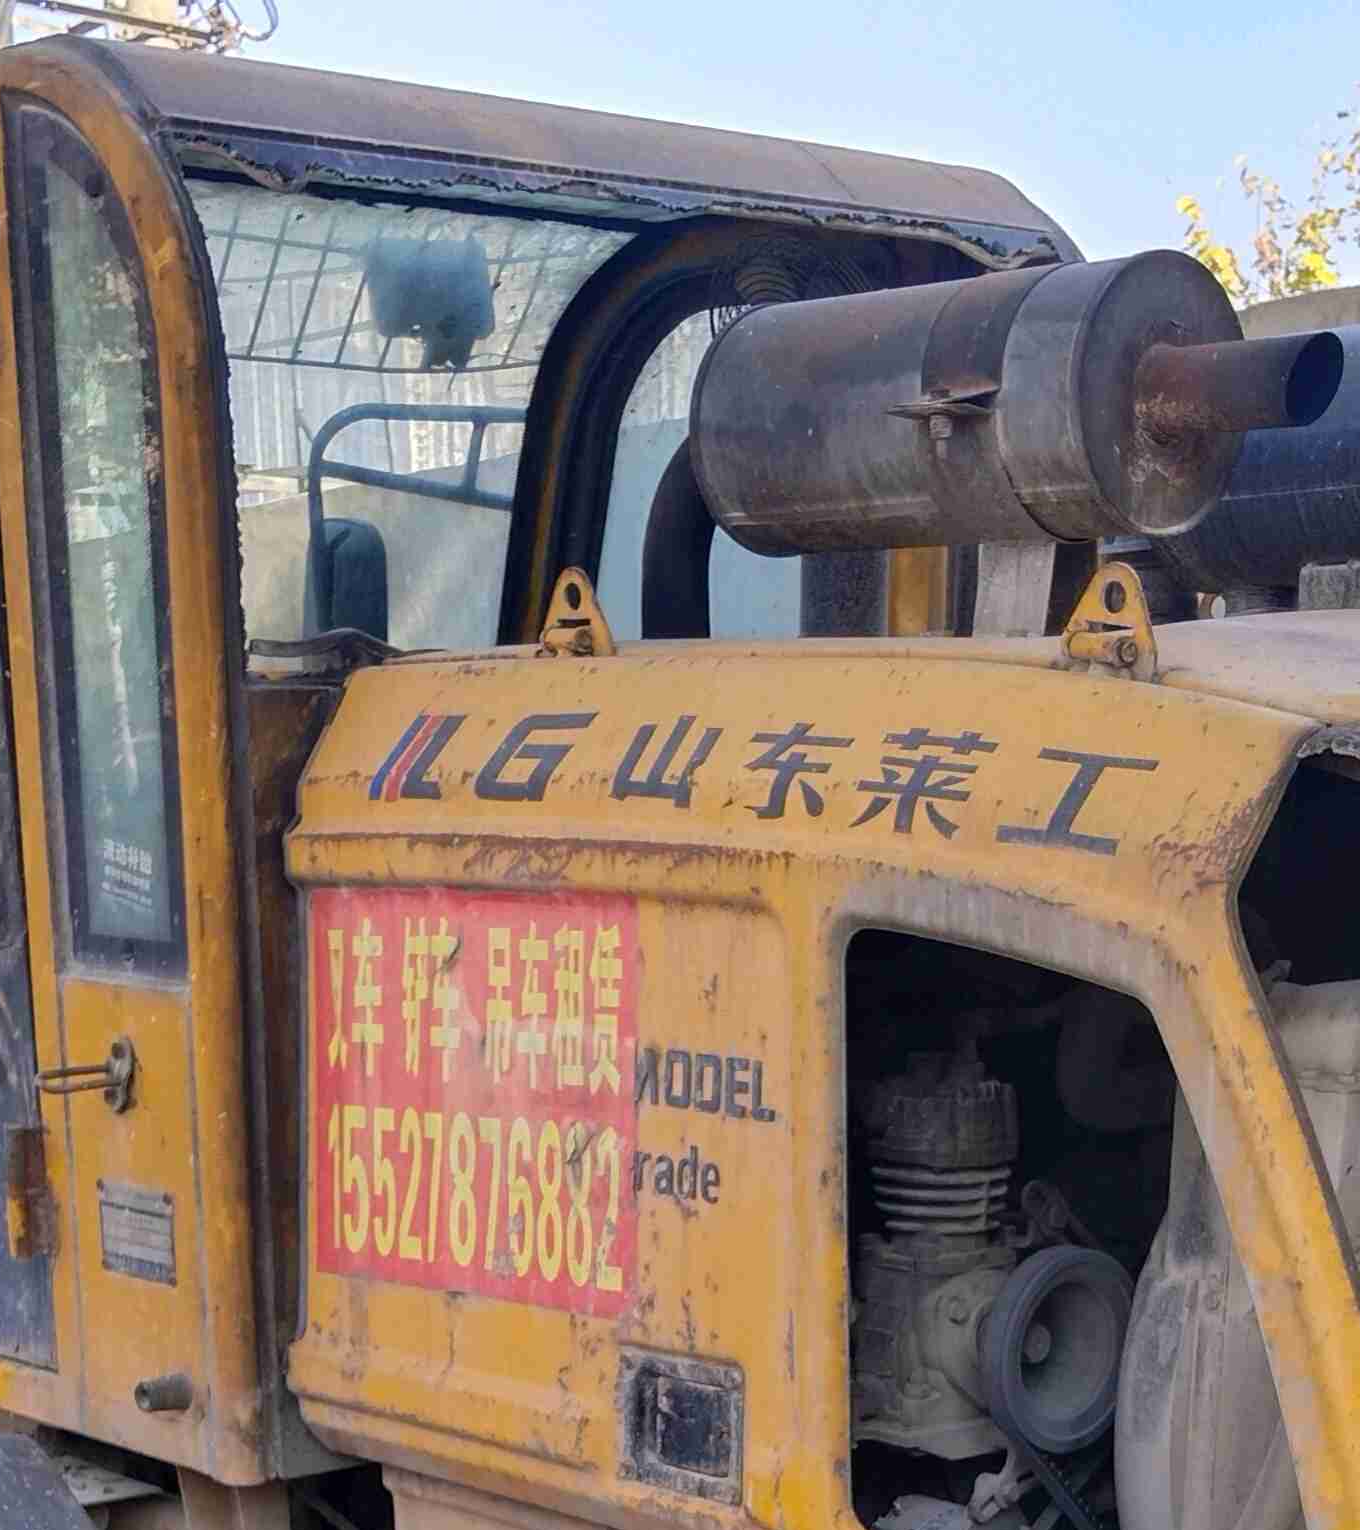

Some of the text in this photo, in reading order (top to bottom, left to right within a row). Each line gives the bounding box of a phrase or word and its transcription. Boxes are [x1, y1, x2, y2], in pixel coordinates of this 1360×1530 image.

[608, 713, 1161, 857] 山东莱工
[327, 915, 625, 1097] 叉车 铲车 吊车租赁
[327, 1103, 624, 1293] 15527876882
[631, 1144, 721, 1205] rade
